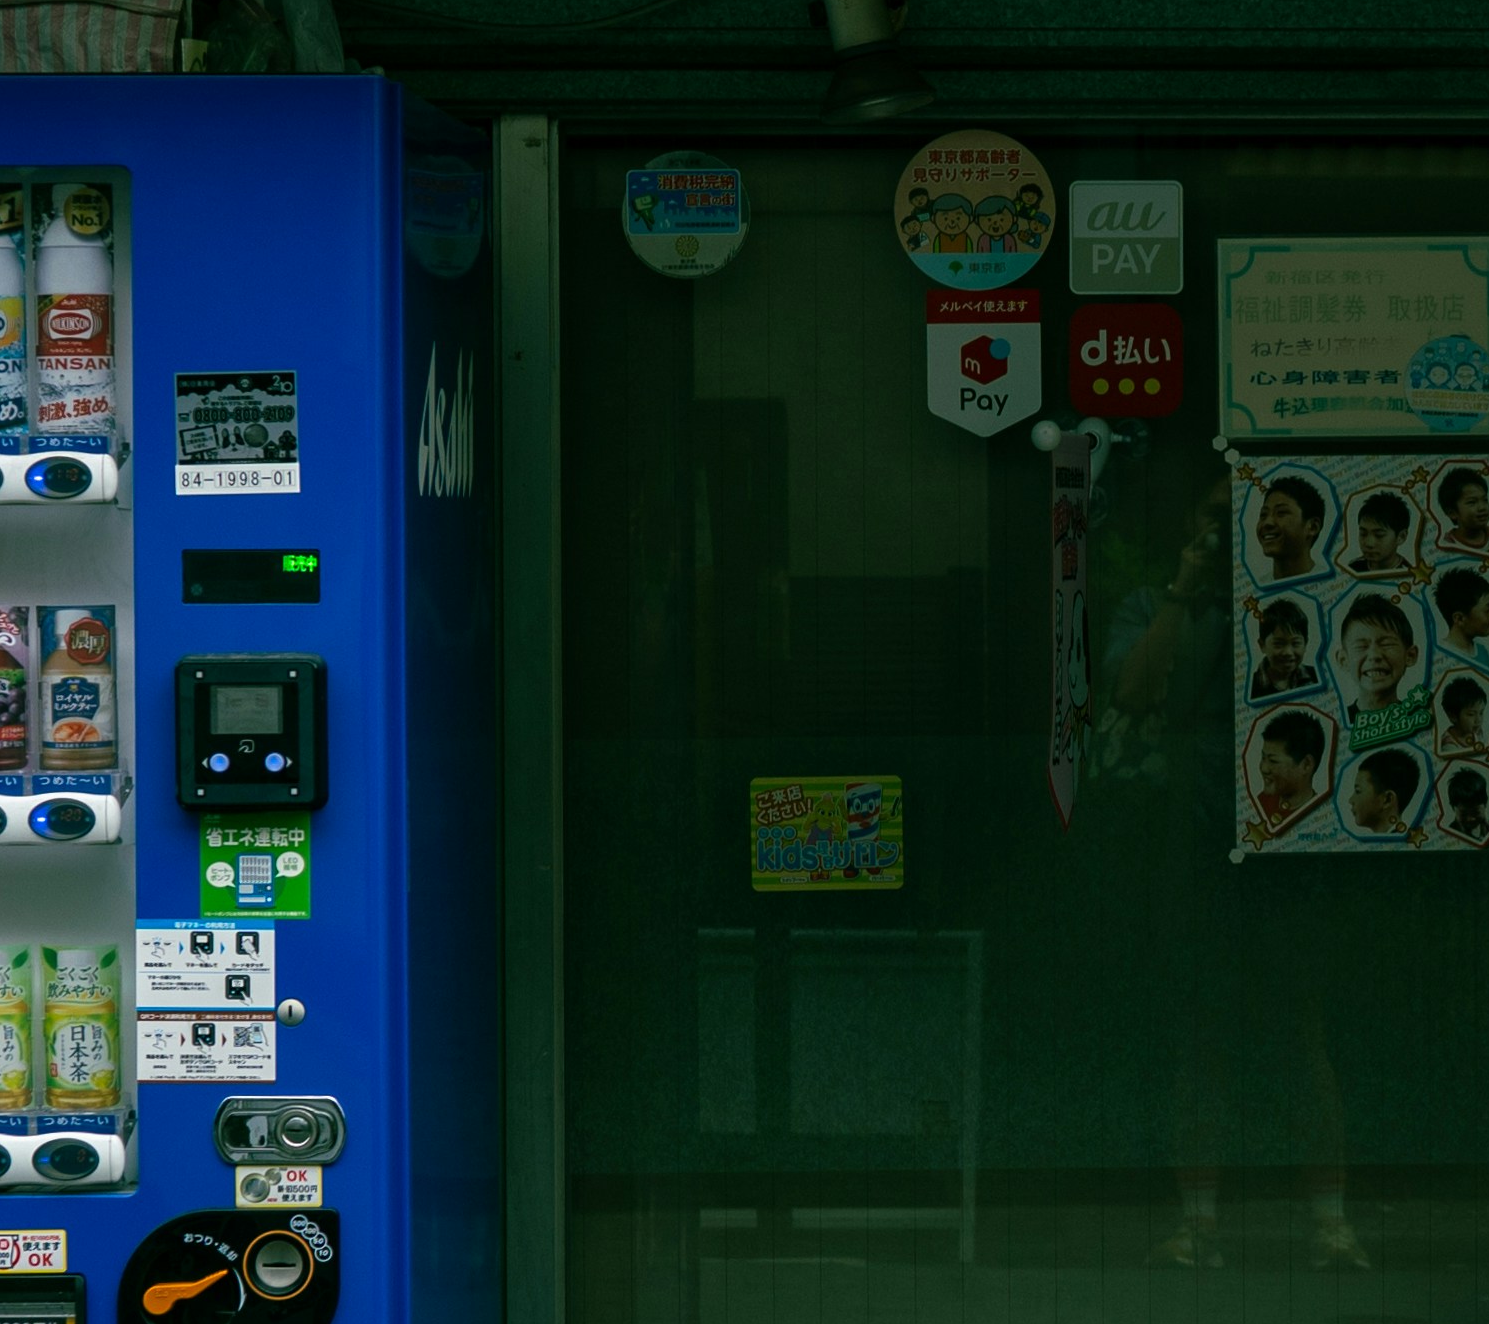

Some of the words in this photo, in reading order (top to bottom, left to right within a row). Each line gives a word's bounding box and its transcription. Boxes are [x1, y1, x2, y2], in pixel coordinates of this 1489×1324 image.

[927, 149, 1021, 166] 東京都高齢者
[657, 174, 736, 190] 消費税完納
[913, 167, 1036, 184] 見守りサポーター
[685, 192, 736, 207] 宣言の街
[71, 213, 103, 228] No.1
[1087, 202, 1166, 233] au
[1092, 243, 1161, 275] PAY
[968, 262, 1006, 275] 東京都
[1266, 270, 1389, 286] 新宿区発行
[939, 298, 1028, 314] メルペイ使えます
[1235, 294, 1367, 324] 福祉調髪券
[1388, 293, 1465, 323] 取扱店
[51, 318, 93, 333] WILKINSON
[1080, 329, 1171, 366] d払い
[38, 357, 111, 371] TANSAN
[1250, 369, 1403, 386] 心身障害者
[38, 397, 114, 423] 刺激、強め。
[960, 388, 1009, 416] Pay
[417, 340, 474, 498] Asahi
[181, 471, 296, 488] 84-1998-01
[282, 554, 318, 572] 販売中
[70, 629, 107, 654] 濃厚
[55, 693, 95, 703] ロイヤル
[53, 702, 98, 712] ミルクティー
[1354, 723, 1393, 744] Short
[1393, 715, 1429, 737] style
[757, 784, 802, 809] ご来店
[757, 798, 813, 825] ください!
[206, 827, 305, 847] 省エネ運転中
[56, 966, 100, 982] ごくごく
[46, 982, 112, 998] 飲みやすい
[2, 1025, 15, 1062] 旨みの
[90, 1025, 104, 1062] 旨みの
[68, 1024, 91, 1083] 日本茶
[287, 1170, 308, 1182] OK
[282, 1194, 313, 1202] 使えます
[22, 1242, 61, 1252] 使えます
[183, 1232, 238, 1262] おつり・返却
[28, 1253, 54, 1267] OK
